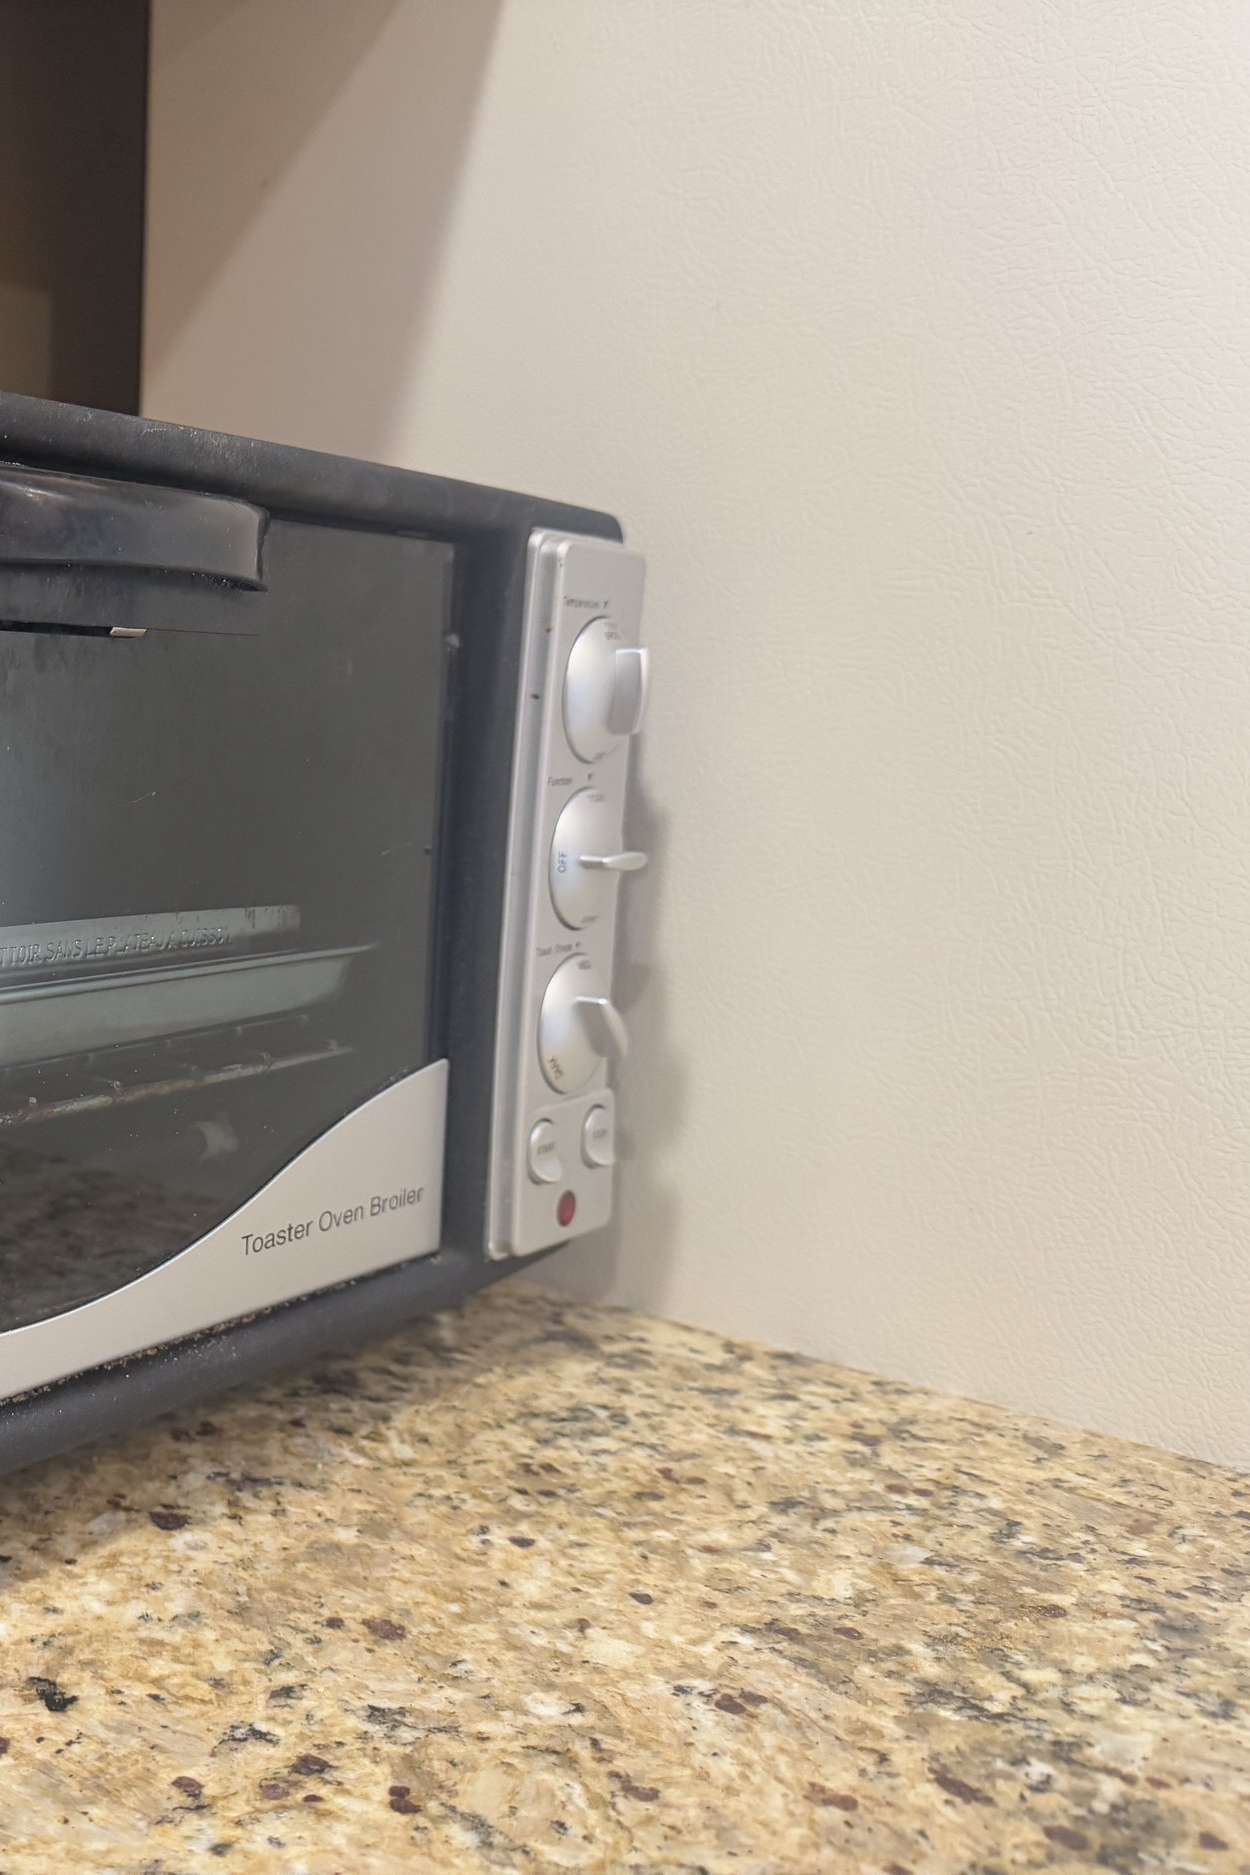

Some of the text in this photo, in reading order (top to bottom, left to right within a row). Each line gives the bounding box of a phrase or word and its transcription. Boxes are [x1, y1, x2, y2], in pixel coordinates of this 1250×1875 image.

[557, 850, 567, 873] OFF
[47, 939, 83, 962] SANS
[241, 1186, 425, 1256] Toaster Oven Broiler
